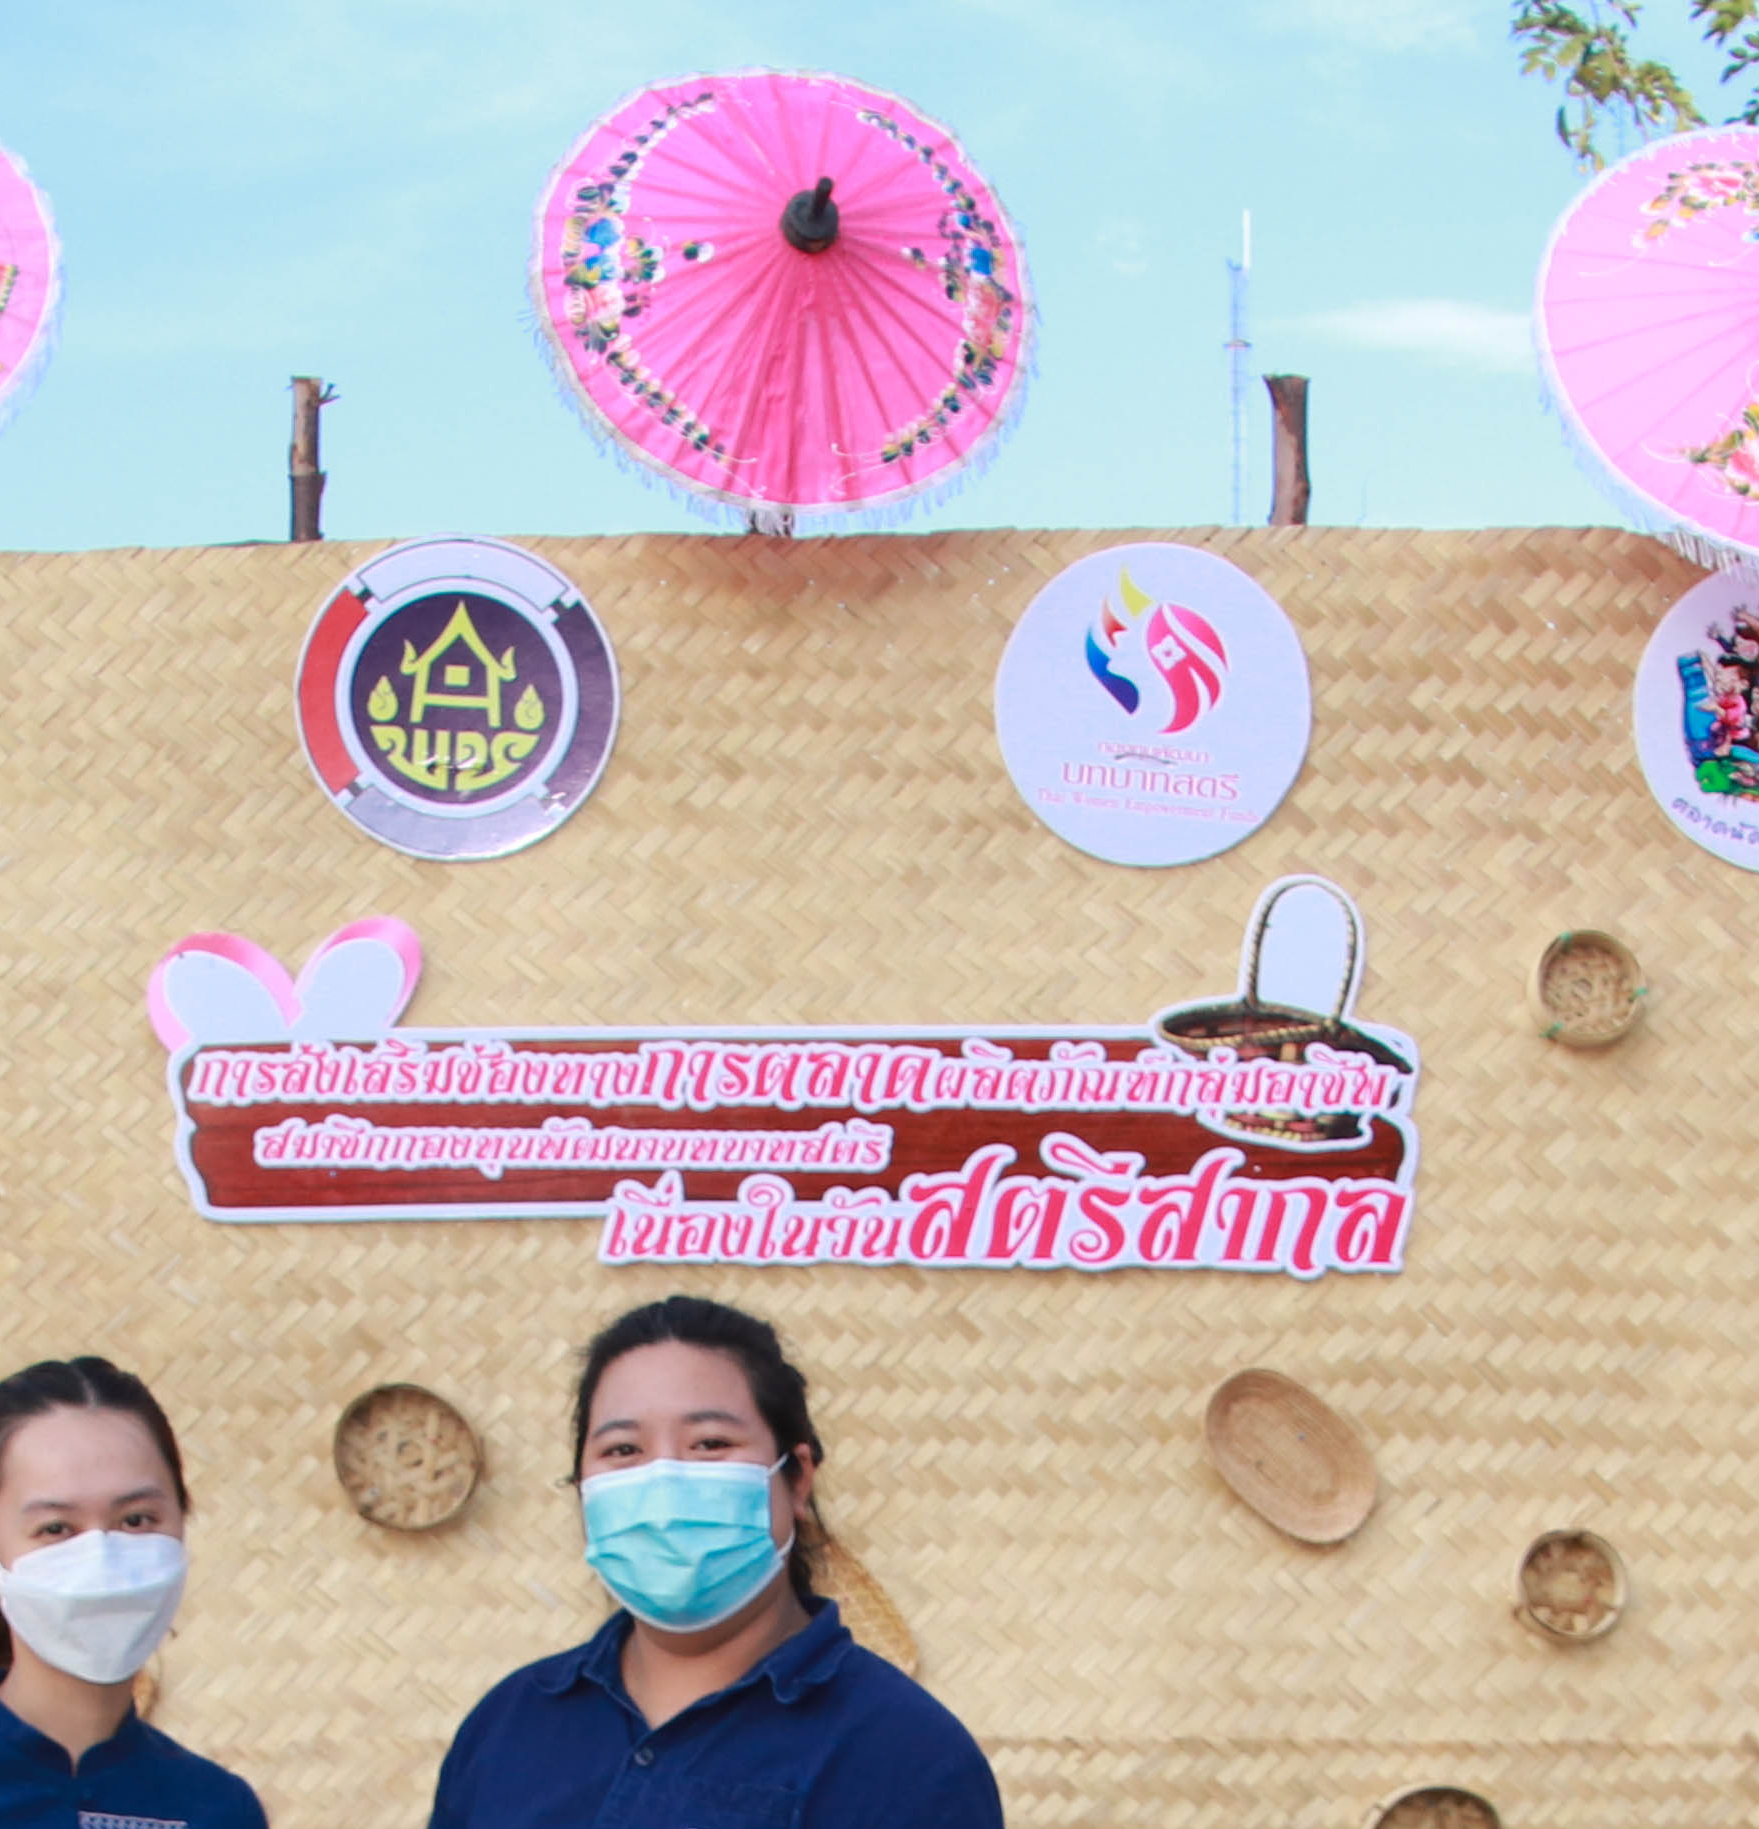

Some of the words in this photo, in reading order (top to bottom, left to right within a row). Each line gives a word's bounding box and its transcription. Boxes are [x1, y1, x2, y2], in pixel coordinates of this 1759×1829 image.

[1061, 761, 1241, 802] บทบาทสตรี
[604, 1140, 1410, 1272] เนื่องในวันสตรีสากล
